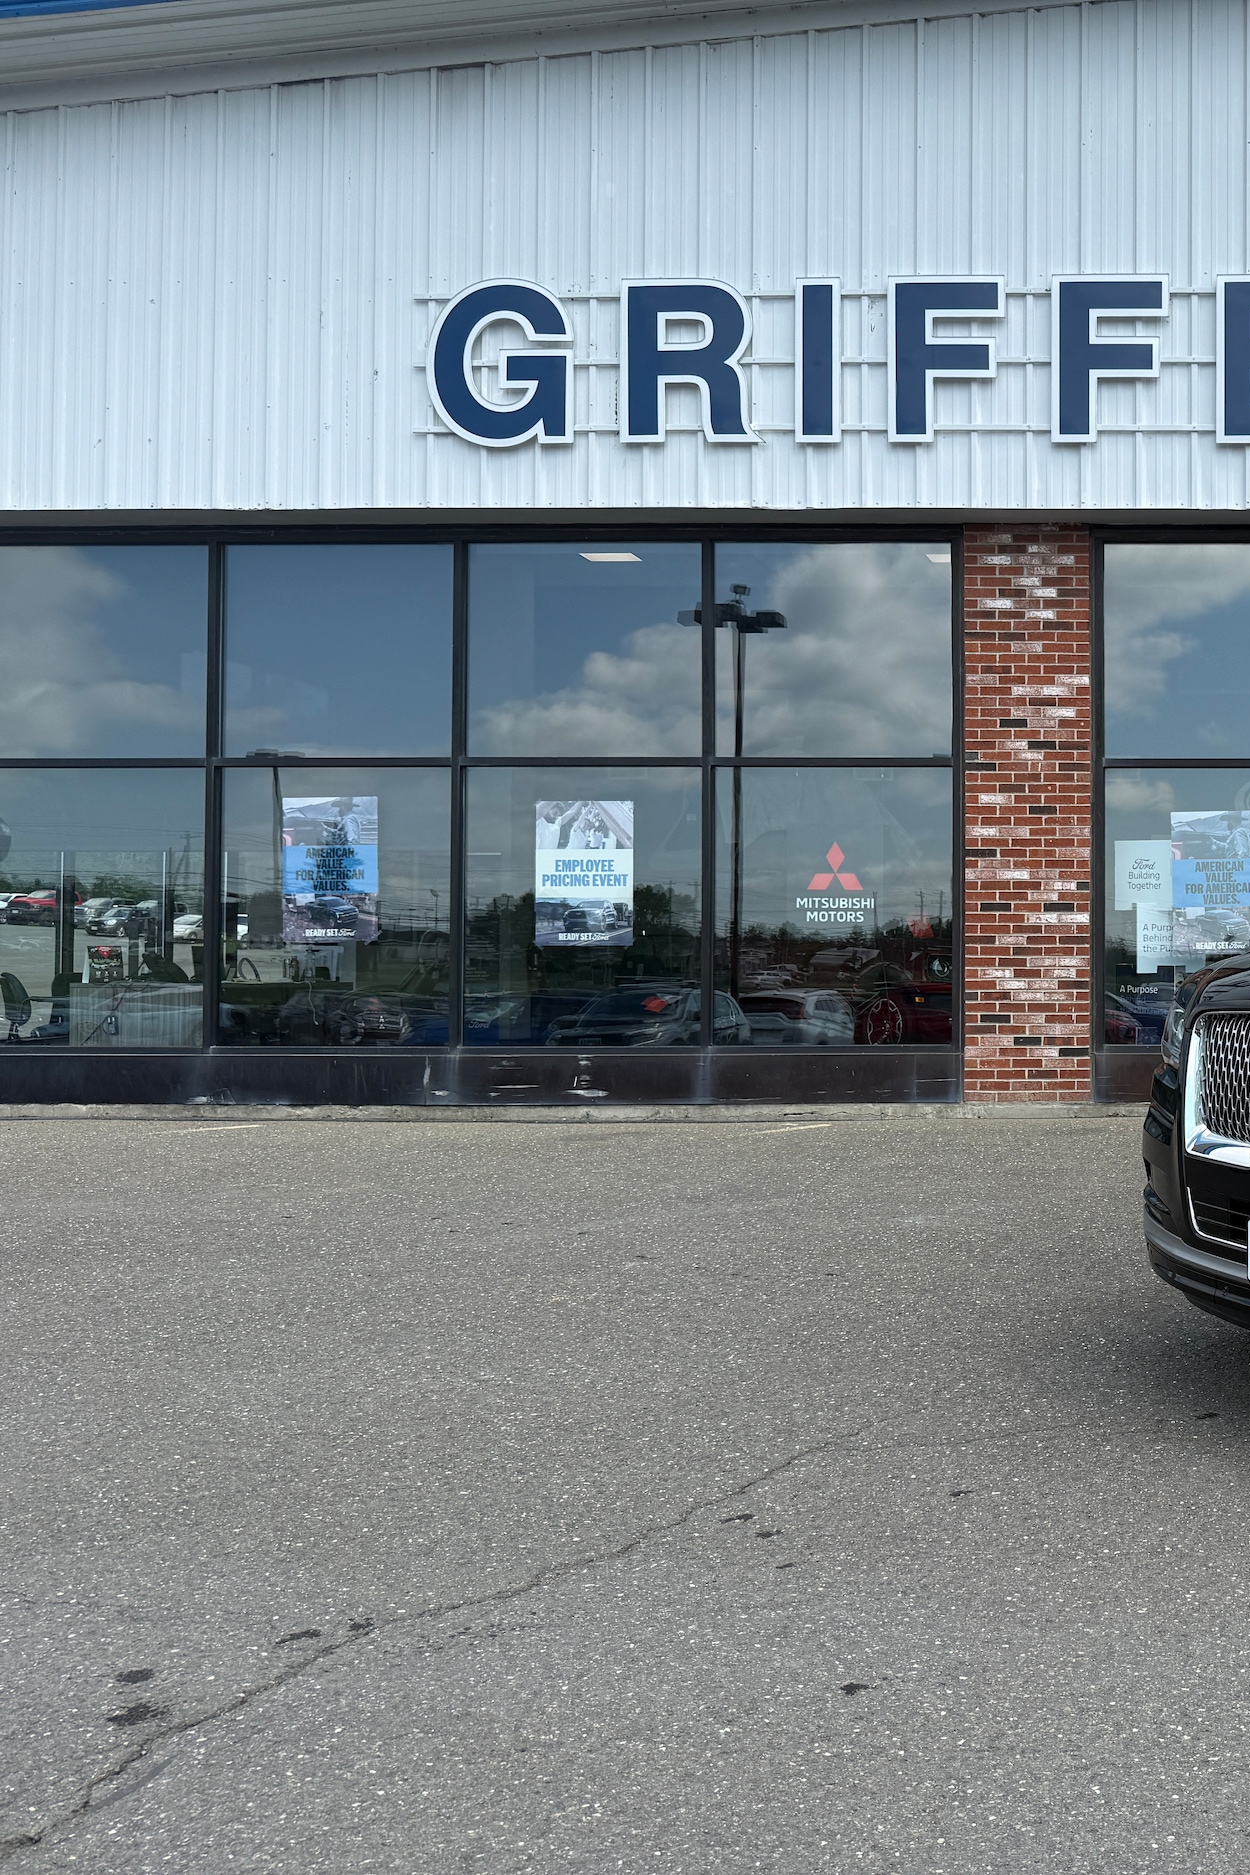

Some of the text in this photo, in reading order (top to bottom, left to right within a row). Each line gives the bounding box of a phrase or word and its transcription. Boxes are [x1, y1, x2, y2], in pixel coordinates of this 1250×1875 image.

[305, 847, 355, 859] AMERICAN
[315, 859, 347, 870] VALUE.
[554, 859, 615, 873] EMPLOYEE
[1132, 859, 1156, 870] Ford
[1194, 860, 1244, 872] AMERICAN
[295, 869, 365, 880] FOR AMERICAN
[1128, 871, 1160, 881] Building
[1205, 871, 1237, 883] VALUE.
[541, 874, 629, 887] PRICING EVENT
[1127, 881, 1162, 891] Together
[312, 881, 350, 892] VALUES.
[1185, 883, 1204, 894] FOR
[796, 897, 875, 909] MITSUBISHI
[1202, 894, 1240, 905] VALUES.
[806, 911, 865, 922] MOTORS
[1142, 923, 1149, 931] A
[305, 929, 326, 937] READY
[326, 929, 338, 937] SET
[558, 932, 580, 941] READY
[580, 932, 592, 941] SET
[1143, 944, 1158, 952] the
[1195, 941, 1216, 949] READY
[1216, 941, 1229, 949] SET
[1119, 985, 1159, 995] A Purpose
[468, 1020, 491, 1029] Ford
